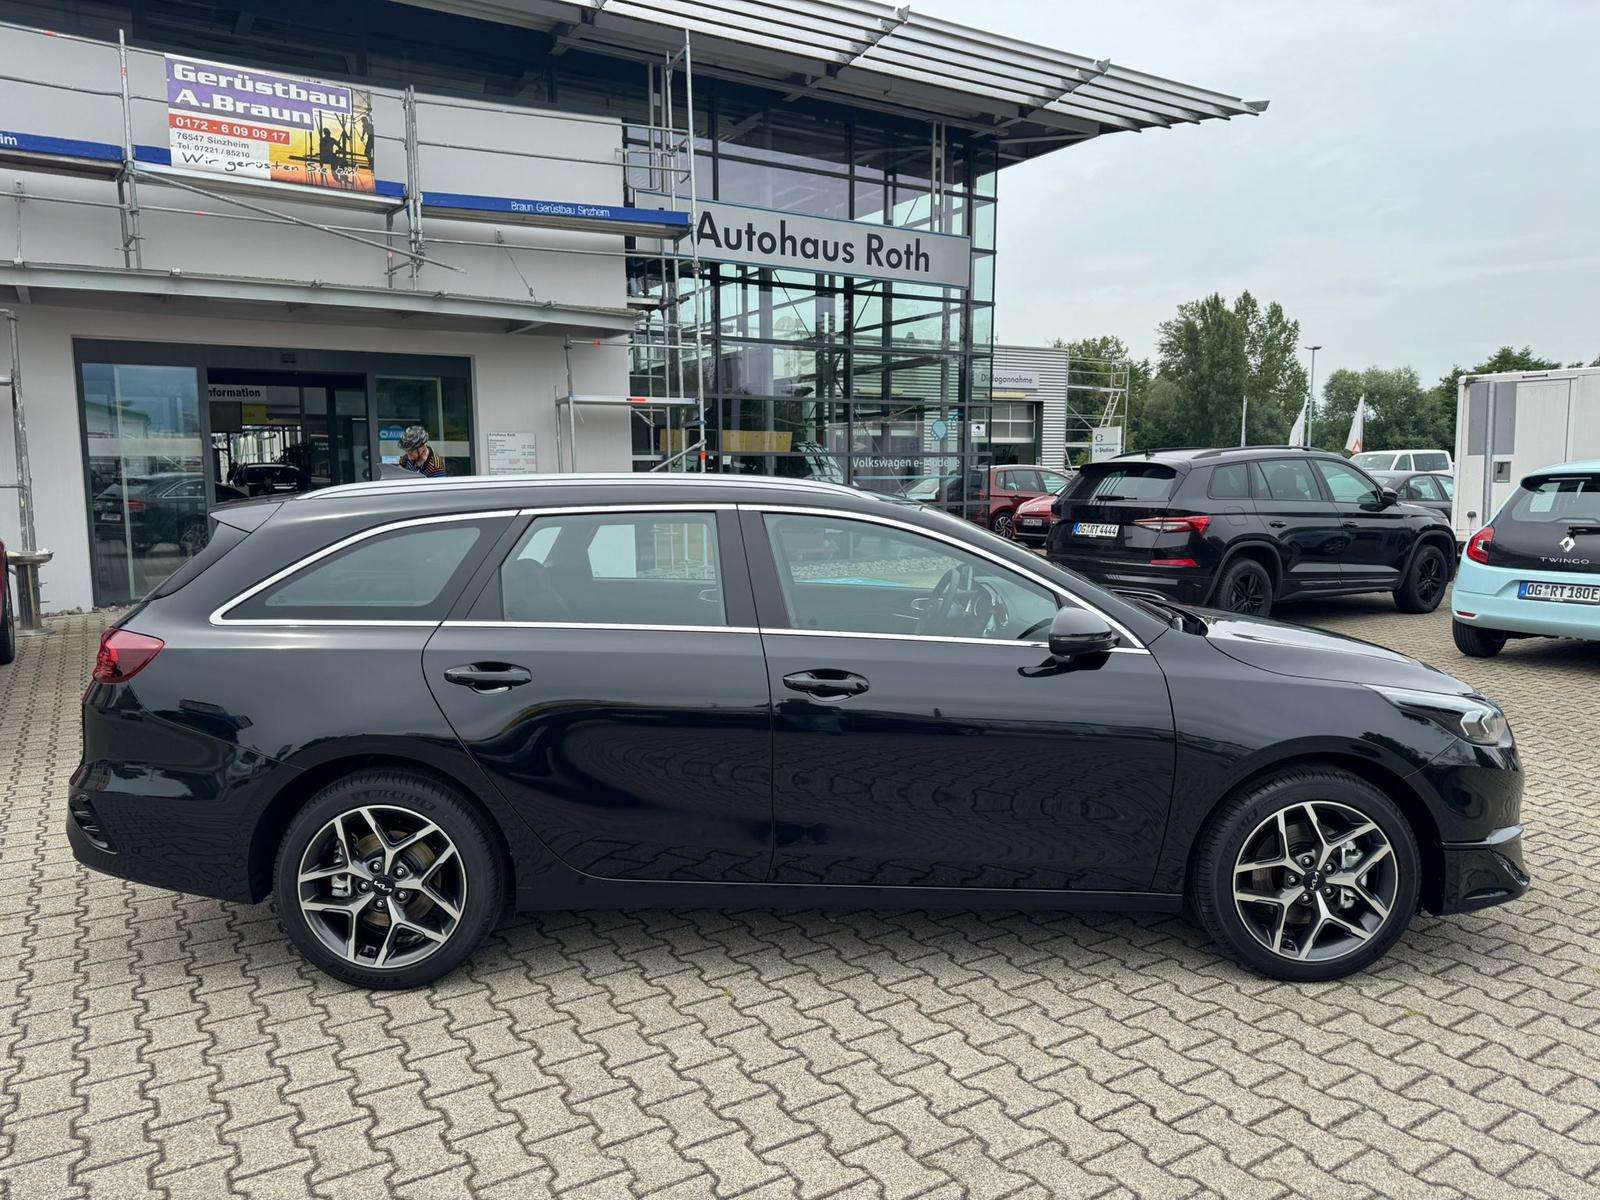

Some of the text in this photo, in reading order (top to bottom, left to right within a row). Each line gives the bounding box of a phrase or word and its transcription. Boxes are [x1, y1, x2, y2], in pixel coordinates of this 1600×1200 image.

[174, 63, 347, 109] Gerüstbau
[174, 88, 311, 125] A.Braun
[176, 117, 207, 130] 0172
[221, 124, 229, 134] 6
[233, 125, 249, 137] 09
[252, 128, 268, 140] 09
[272, 130, 287, 142] 17
[176, 131, 250, 149] 76547 Sinzheim
[177, 142, 192, 151] Tel.
[194, 144, 218, 154] 07221
[182, 151, 220, 164] Wir
[511, 201, 610, 217] Braun Gerüstbau Sinzheim
[697, 210, 930, 272] Autohaus Roth
[208, 387, 261, 397] nformation
[852, 457, 912, 470] Volkswagen
[1540, 556, 1590, 564] TWINGO
[1527, 584, 1543, 595] OG
[1567, 586, 1600, 600] 180E
